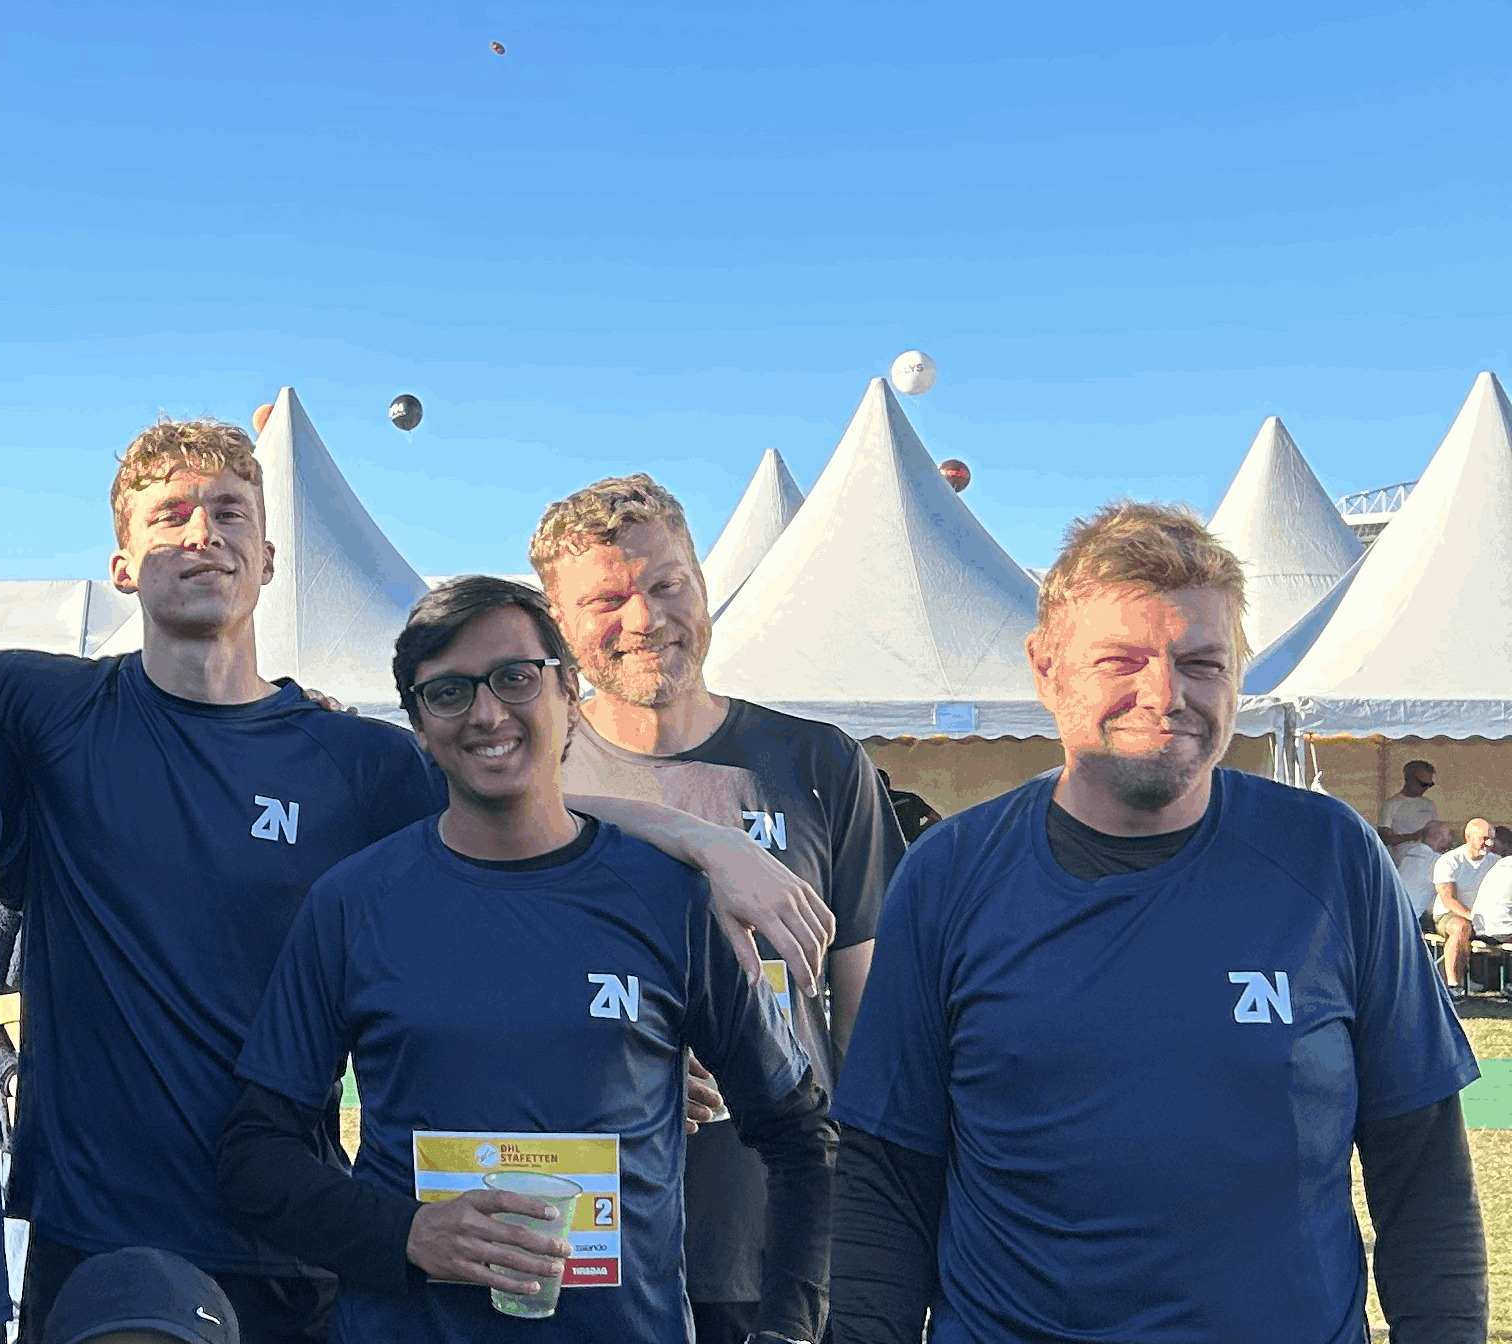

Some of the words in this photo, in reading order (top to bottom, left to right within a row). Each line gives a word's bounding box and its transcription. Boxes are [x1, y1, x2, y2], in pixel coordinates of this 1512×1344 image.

[500, 1144, 520, 1153] DHL
[500, 1154, 558, 1163] STAFETTEN
[596, 1198, 613, 1225] 2
